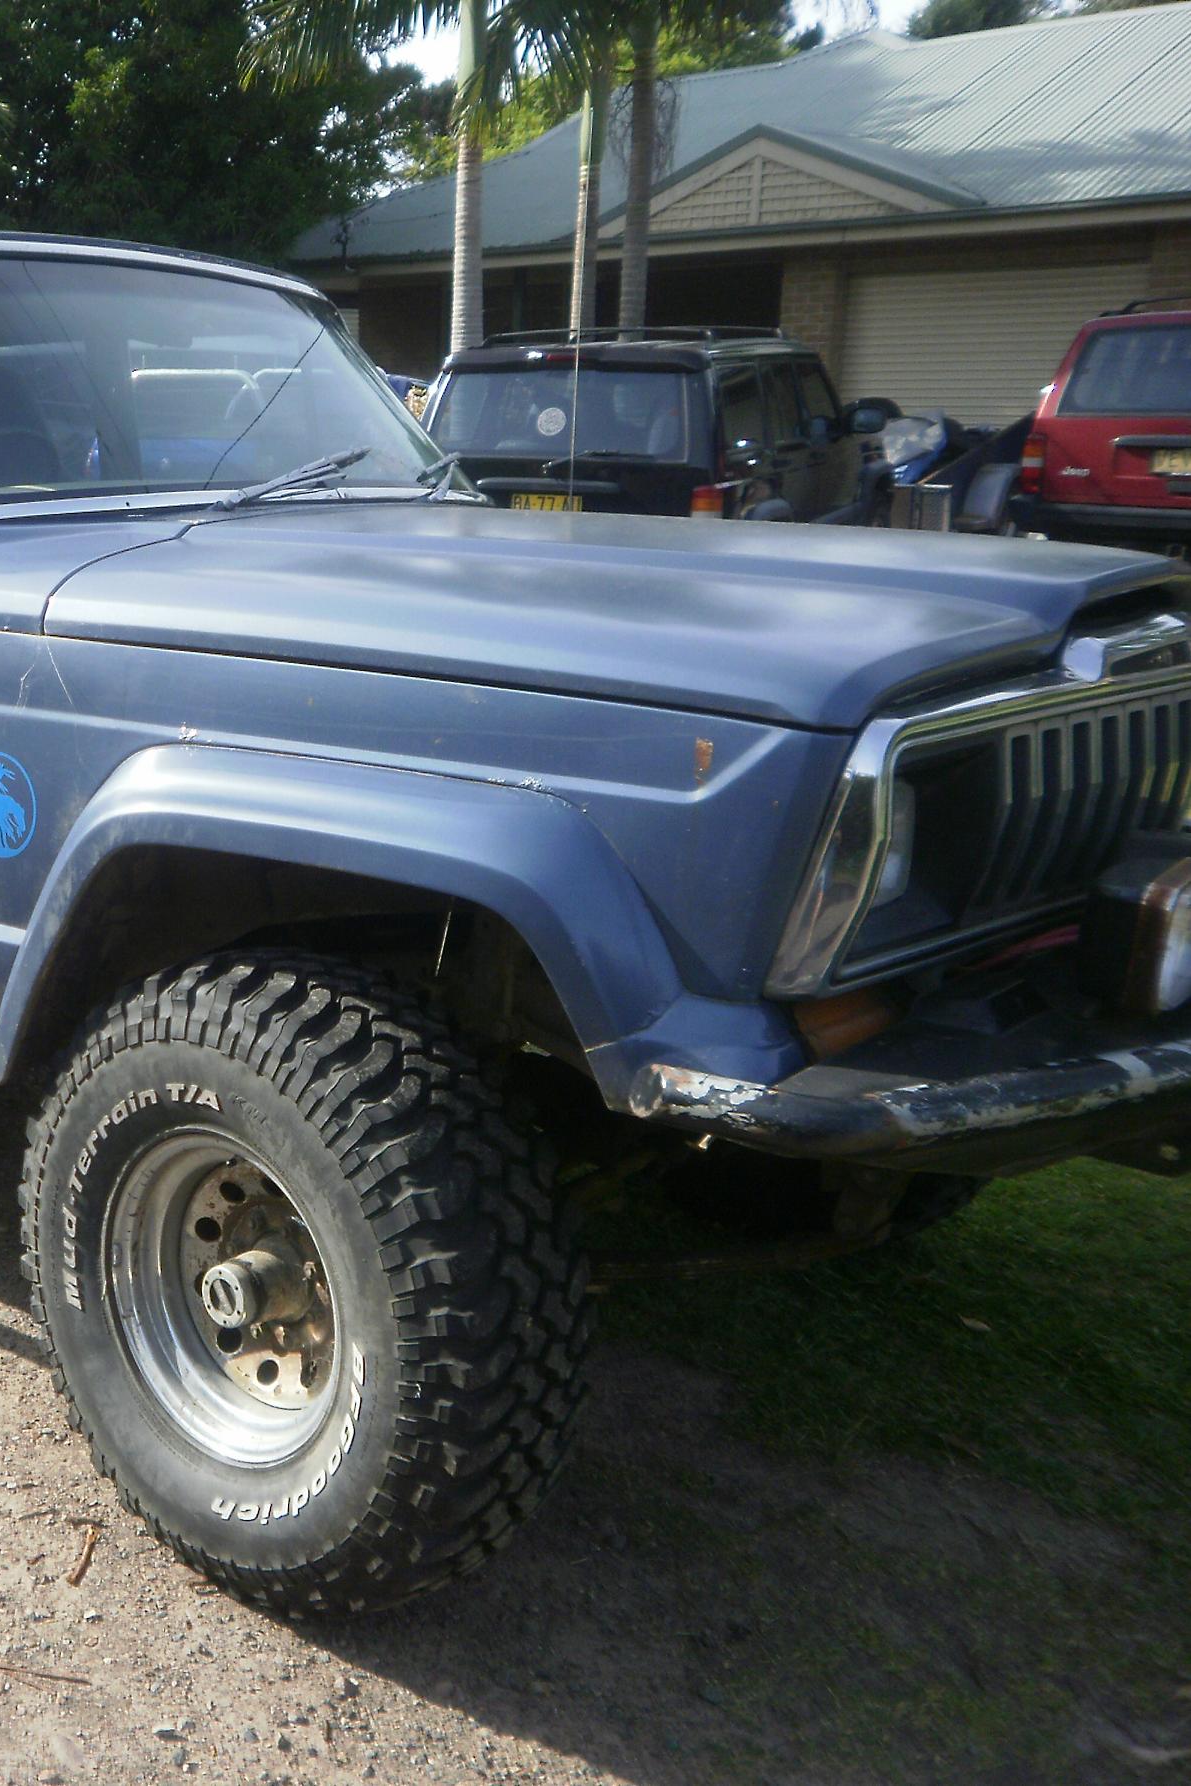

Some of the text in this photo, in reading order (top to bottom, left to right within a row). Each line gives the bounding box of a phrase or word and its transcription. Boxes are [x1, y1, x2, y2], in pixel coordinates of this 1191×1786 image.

[1060, 466, 1090, 477] Jeep
[61, 1088, 159, 1311] Mud-Terrain
[165, 1082, 221, 1112] T/A
[210, 1342, 365, 1525] BFGoodrich
